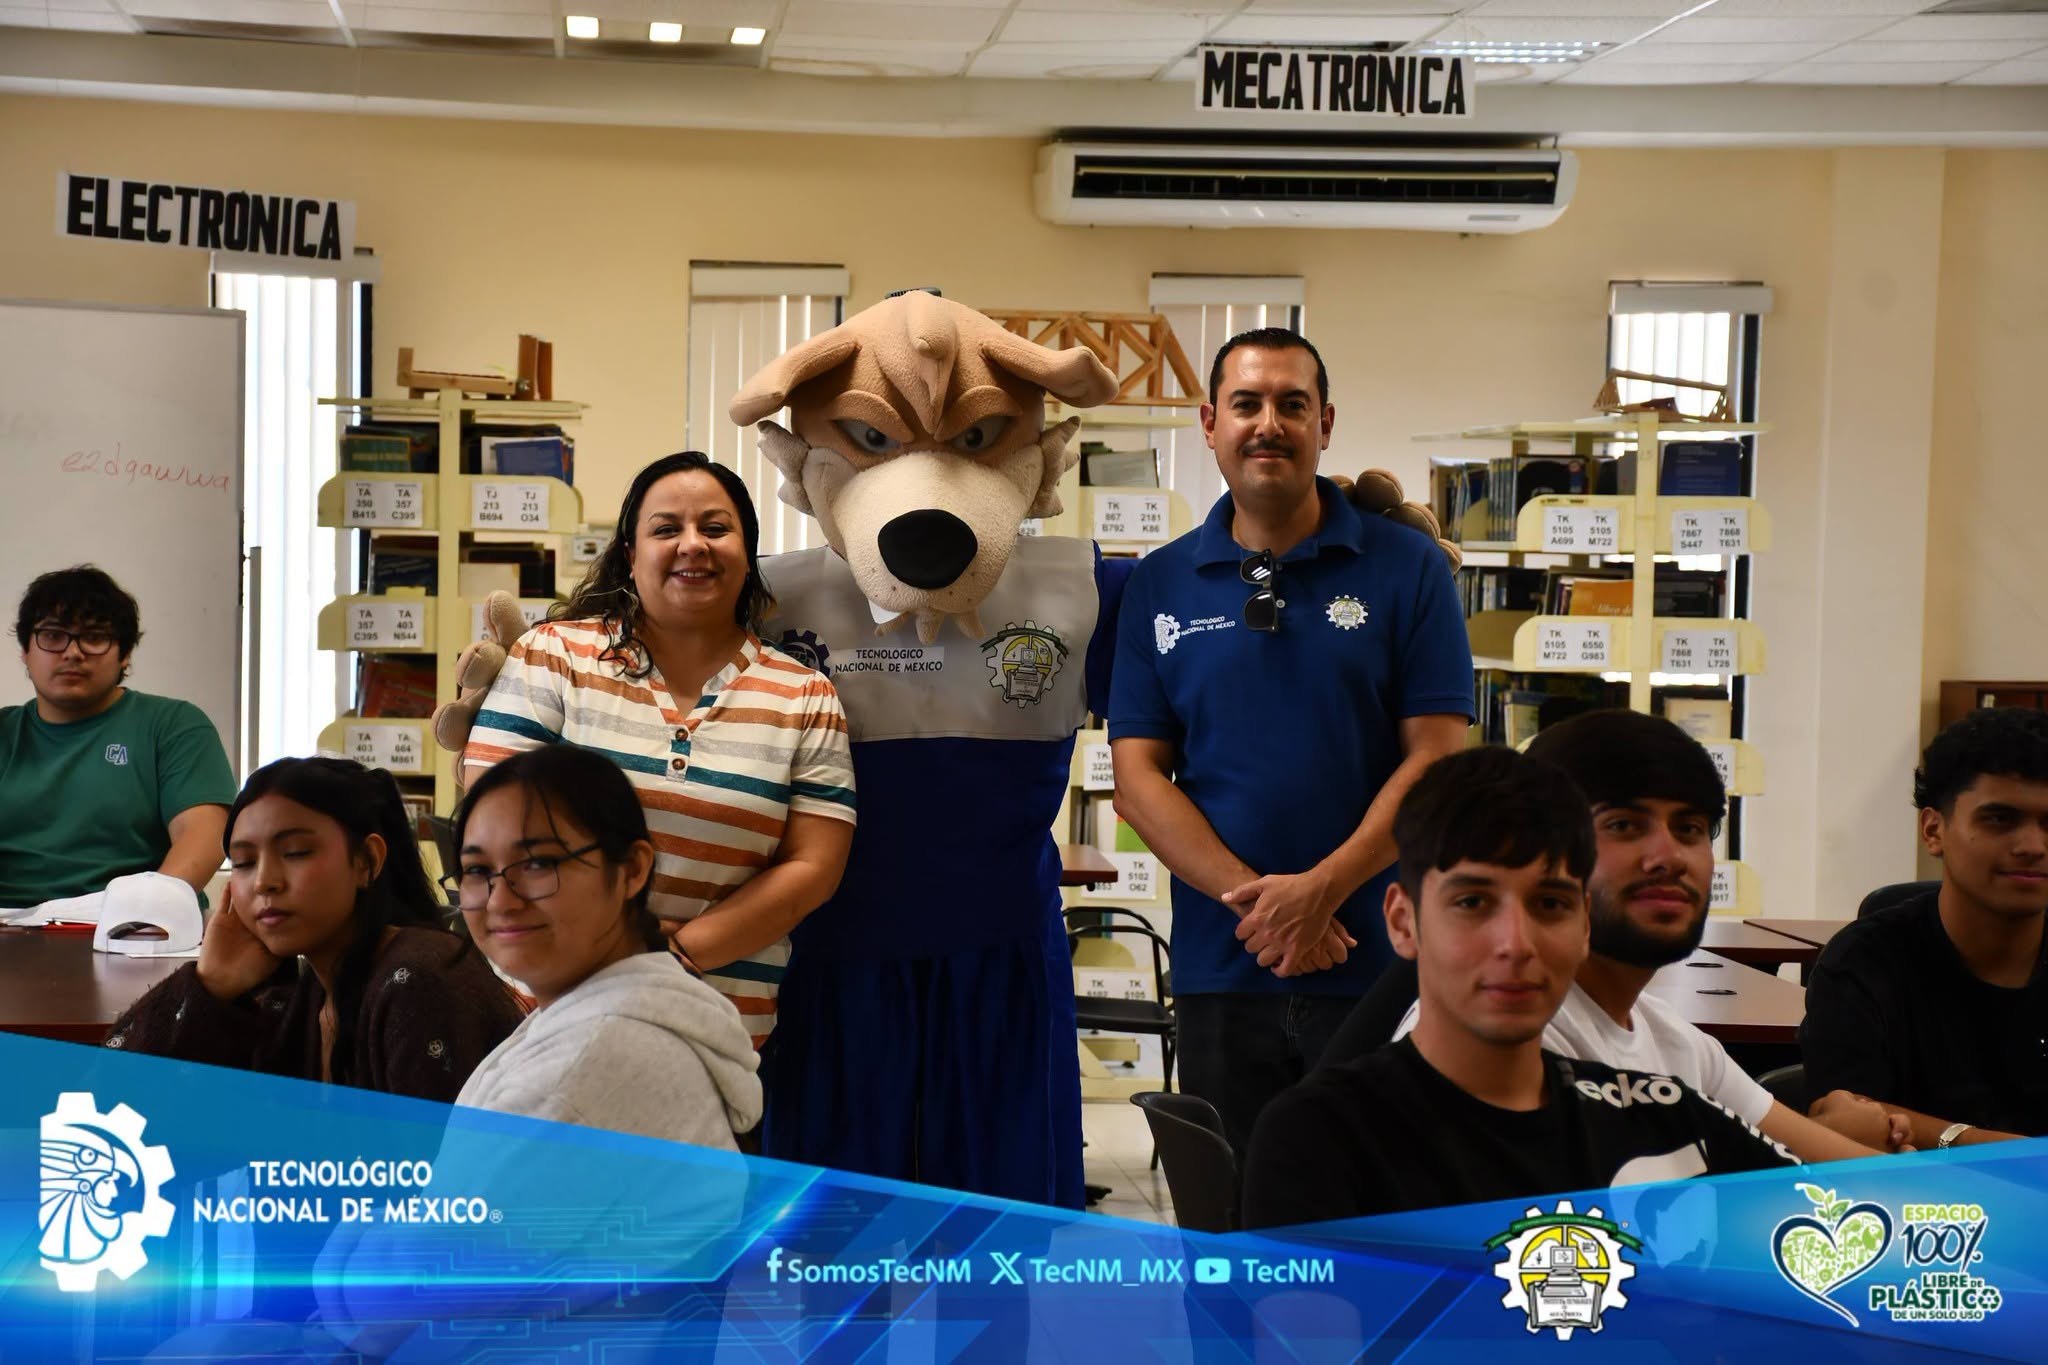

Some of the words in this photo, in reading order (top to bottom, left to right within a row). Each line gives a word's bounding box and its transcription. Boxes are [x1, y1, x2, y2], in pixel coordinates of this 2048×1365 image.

[358, 487, 372, 497] TA
[397, 488, 411, 498] TA
[486, 489, 498, 500] TJ
[525, 490, 537, 501] TJ
[395, 499, 412, 509] 357
[482, 501, 500, 511] 213
[521, 502, 539, 512] 213
[1107, 501, 1120, 510] TK
[1145, 502, 1158, 511] TK
[351, 509, 377, 520] B415
[391, 510, 416, 521] C395
[1557, 514, 1569, 523] TK
[1595, 515, 1607, 524] TK
[1684, 518, 1698, 527] TK
[1723, 516, 1736, 526] TK
[1101, 523, 1125, 533] B792
[1551, 525, 1574, 535] 5105
[1589, 526, 1612, 536] 5105
[1550, 536, 1575, 545] A699
[1588, 537, 1613, 547] M722
[359, 609, 373, 619] TA
[398, 609, 412, 619] TA
[396, 620, 414, 630] 403
[353, 631, 379, 642] C395
[392, 631, 417, 641] N544
[1549, 629, 1562, 638] TK
[1587, 629, 1600, 639] TK
[1544, 640, 1567, 649] 5105
[1582, 640, 1605, 650] 6550
[1675, 637, 1688, 646] TK
[1712, 637, 1726, 646] TK
[1543, 651, 1567, 660] M722
[1708, 648, 1730, 658] 7871
[835, 663, 885, 673] NACIONAL
[888, 663, 901, 673] DE
[357, 732, 372, 742] TA
[397, 733, 411, 742] TA
[1096, 751, 1109, 760] TK
[1133, 860, 1145, 870] TK
[1091, 979, 1104, 988] TK
[1129, 979, 1142, 988] TK
